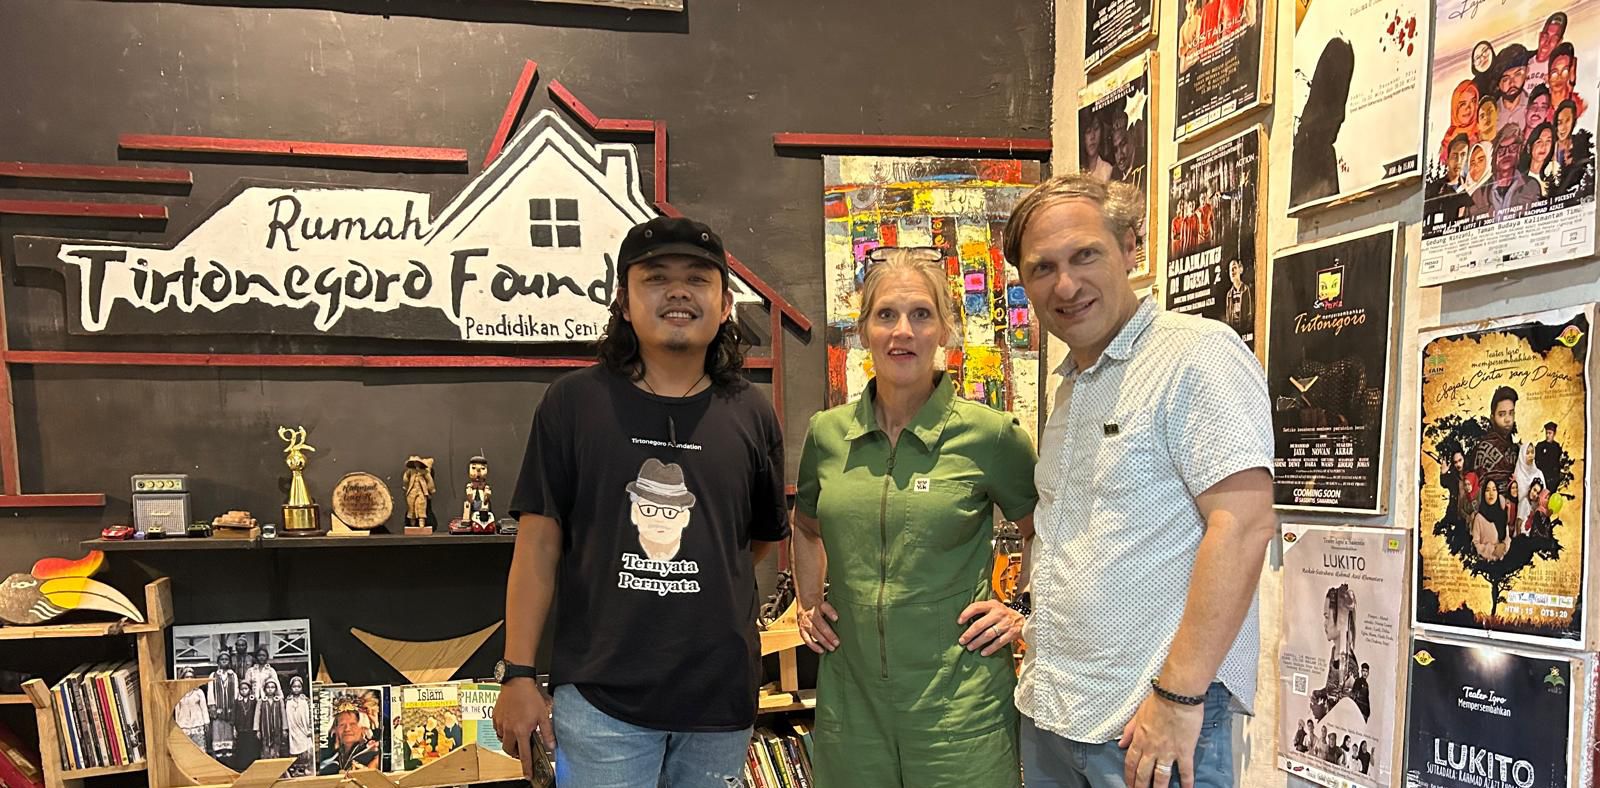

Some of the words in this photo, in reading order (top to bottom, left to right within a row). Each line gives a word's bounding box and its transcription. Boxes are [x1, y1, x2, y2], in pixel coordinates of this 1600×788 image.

[1236, 153, 1255, 168] ACTION
[266, 194, 433, 251] Rumah
[1498, 219, 1521, 229] Budaya
[1524, 211, 1564, 224] Kalimantan
[1566, 207, 1582, 215] Timu
[66, 250, 432, 325] Tirtonegoro
[465, 314, 560, 339] Pendidikan
[564, 317, 598, 339] Seni
[1294, 312, 1366, 336] Tirtonegoro
[1471, 354, 1539, 368] mempersembahkan
[1436, 378, 1469, 402] Sajak
[1468, 367, 1508, 390] Cinta
[1509, 370, 1531, 387] sang
[631, 437, 667, 447] Tirtonegoro
[667, 441, 702, 450] Fndation
[1311, 448, 1331, 456] NOVAN
[1293, 488, 1323, 498] COOMING
[1323, 488, 1342, 498] SOON
[622, 552, 699, 576] Ternyata
[1323, 553, 1366, 571] LUKITO
[618, 572, 701, 597] Pernyata
[1540, 609, 1554, 617] OTS
[417, 688, 444, 701] Islam
[1462, 686, 1488, 700] Teater
[1458, 697, 1512, 718] Mempersembahkan
[320, 691, 329, 748] KALIMANTAN
[1434, 738, 1535, 788] LUKITO
